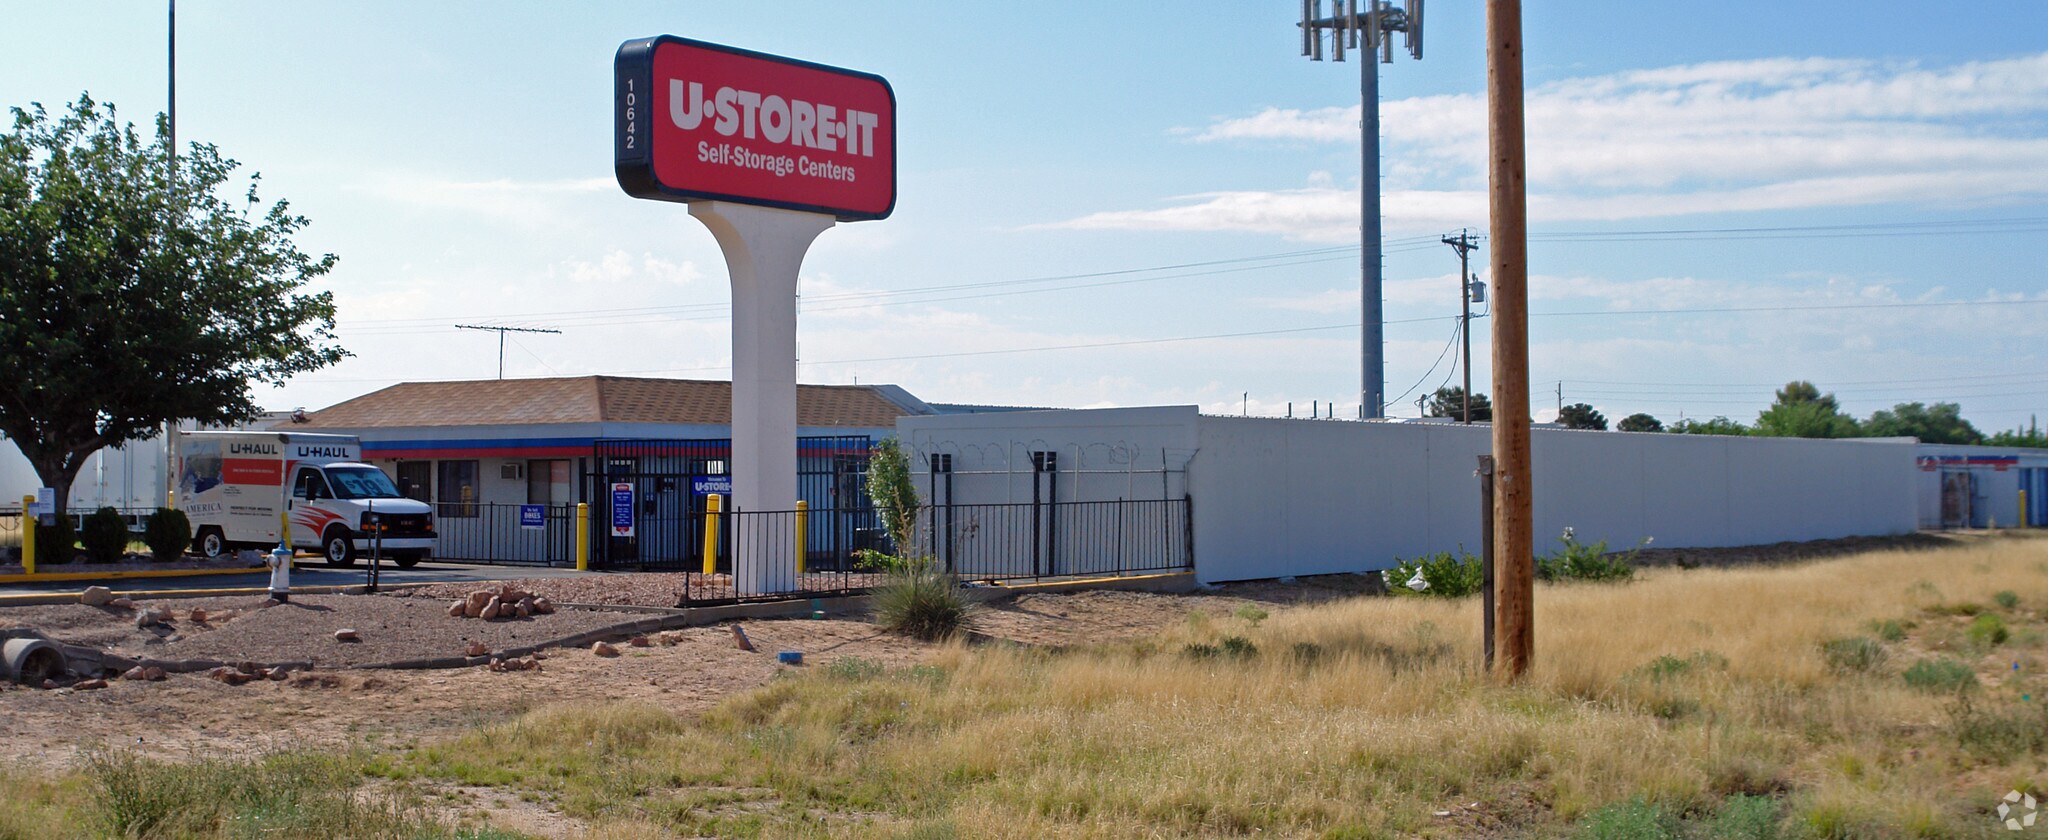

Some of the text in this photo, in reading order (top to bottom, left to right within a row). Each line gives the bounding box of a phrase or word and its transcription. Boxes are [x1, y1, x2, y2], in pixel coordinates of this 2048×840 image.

[626, 78, 636, 149] 10642
[697, 141, 856, 182] Self-Storage Centers
[230, 443, 278, 454] U-HAUL
[298, 446, 349, 458] U-HAUL
[186, 502, 222, 513] AMERICA
